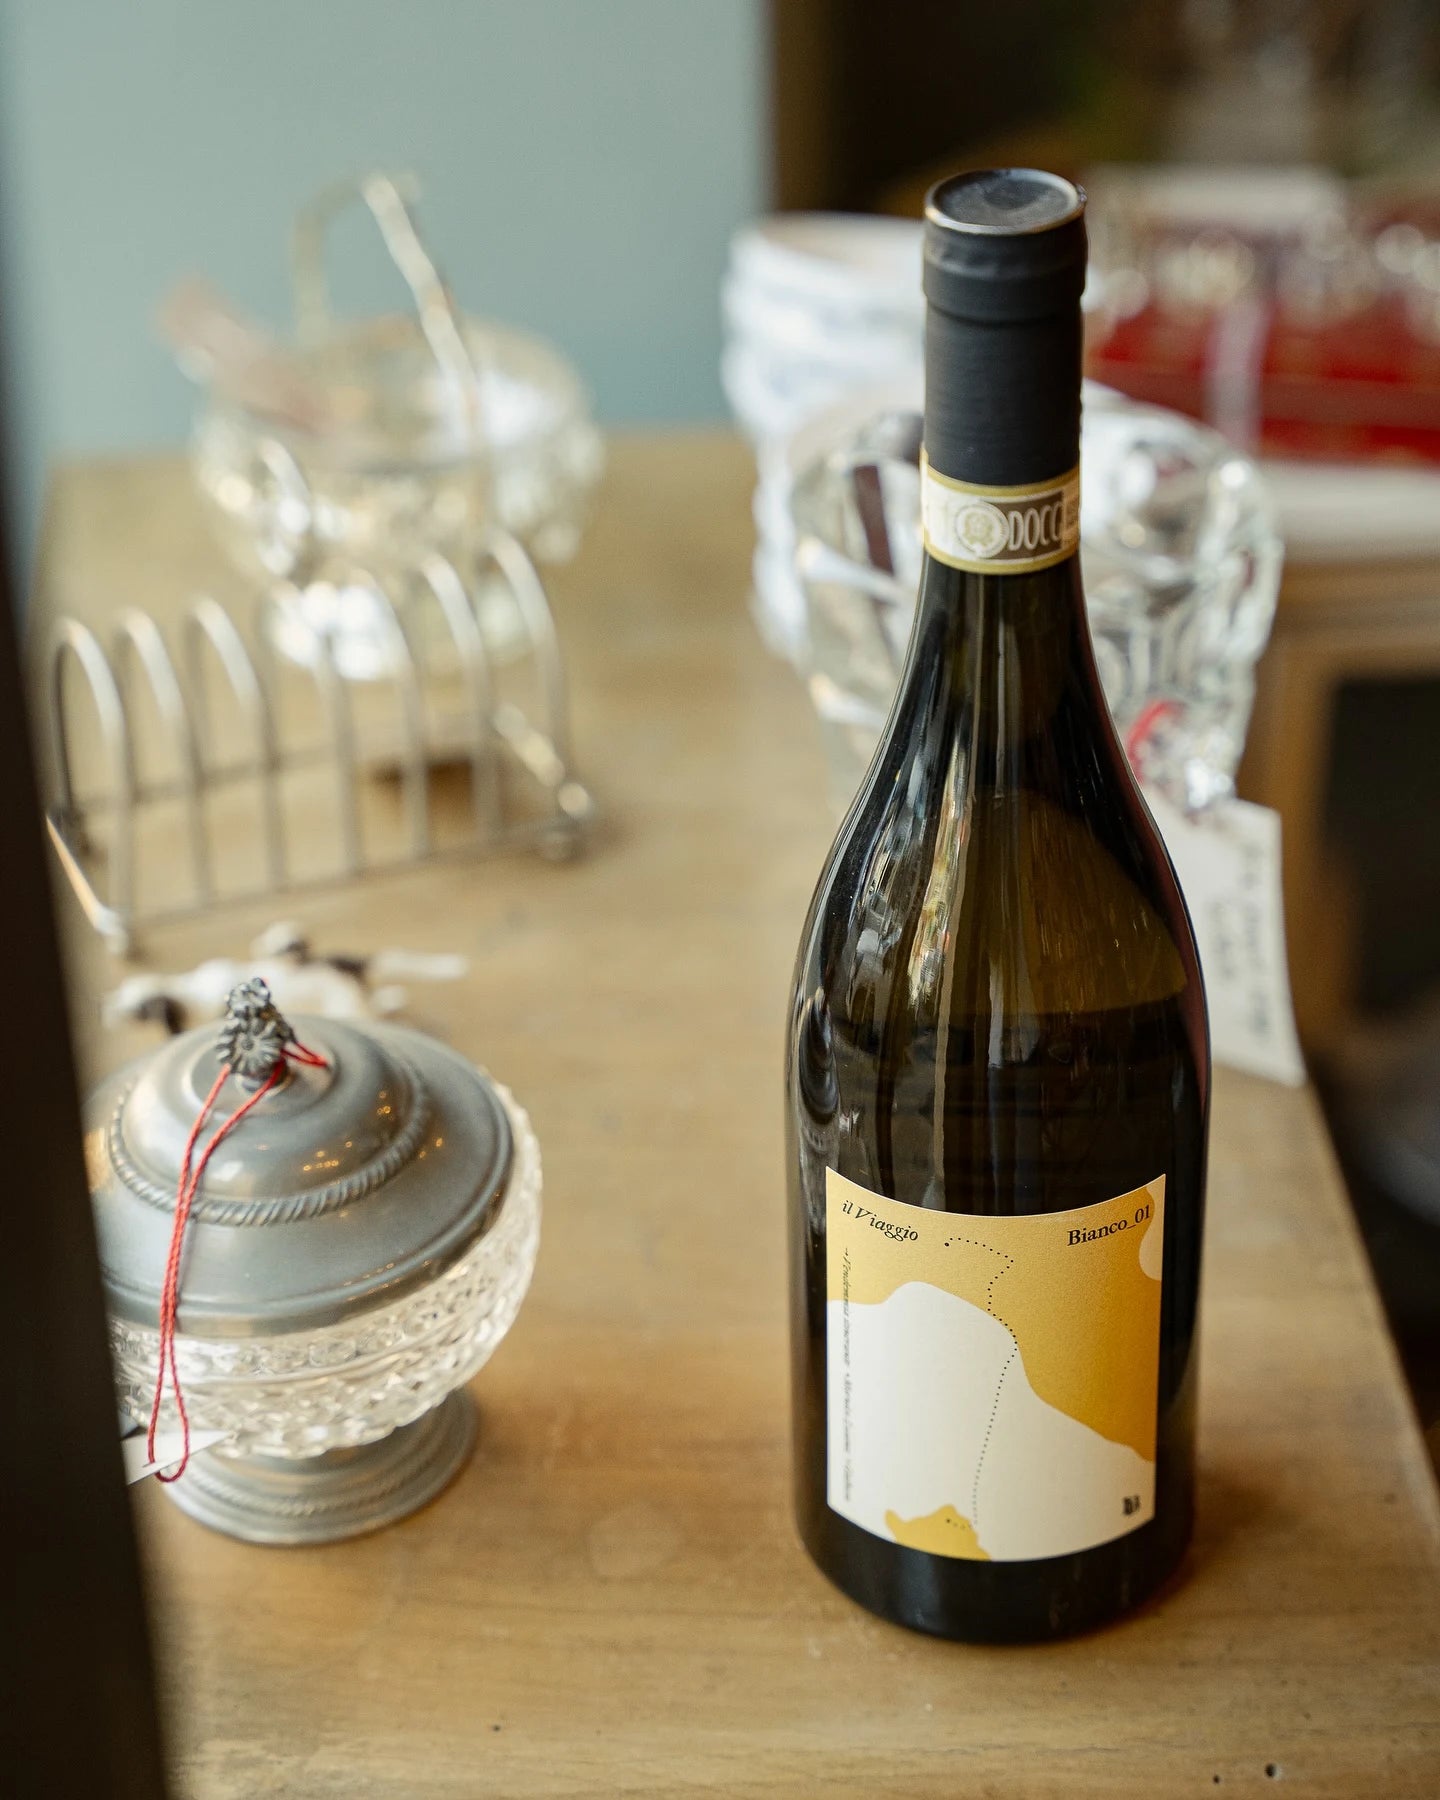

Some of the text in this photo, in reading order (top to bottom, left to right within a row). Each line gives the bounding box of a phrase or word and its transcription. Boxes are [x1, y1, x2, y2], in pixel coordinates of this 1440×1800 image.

[842, 1200, 919, 1242] il Viaggio
[1066, 1204, 1151, 1247] Bianco_01
